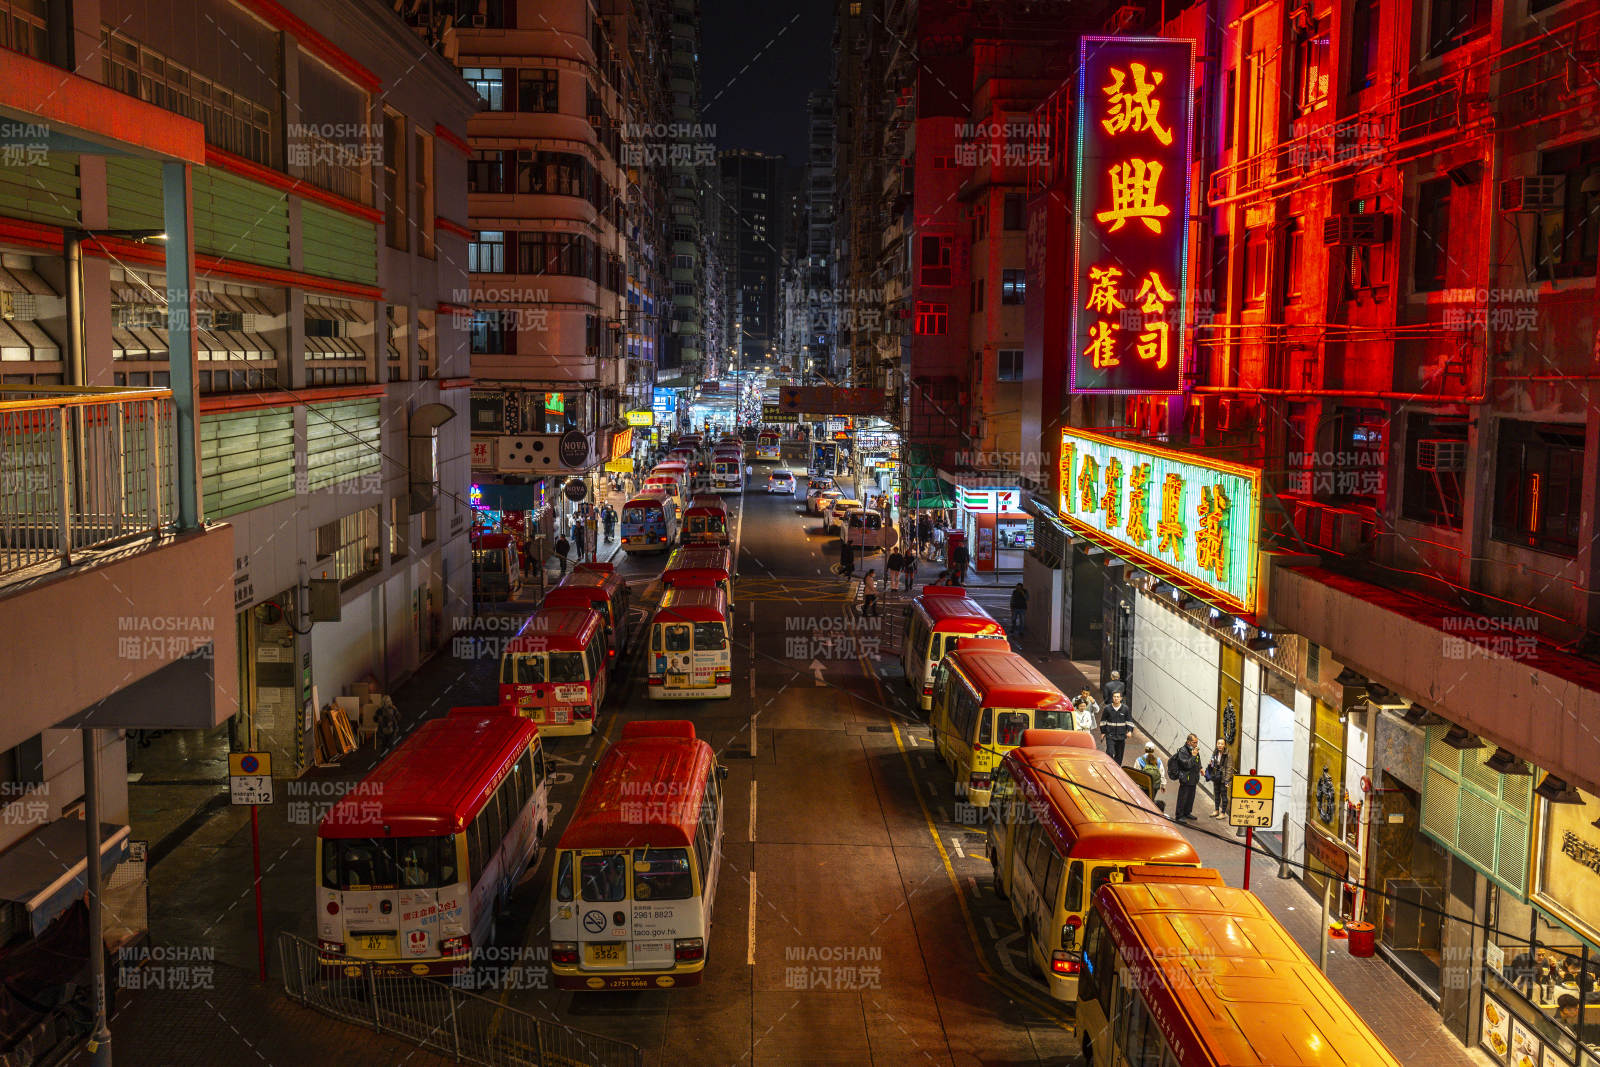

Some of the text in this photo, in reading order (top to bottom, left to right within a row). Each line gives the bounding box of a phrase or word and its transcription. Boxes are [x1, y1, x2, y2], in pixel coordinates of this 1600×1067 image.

[1097, 62, 1173, 234] 誠興
[1135, 271, 1174, 369] 公司
[564, 441, 586, 454] NOVA
[998, 492, 1012, 511] 7
[256, 778, 263, 787] 7
[258, 793, 270, 803] 12
[1257, 801, 1265, 811] 7
[1257, 816, 1270, 826] 12
[633, 910, 673, 919] 2961 8823
[633, 927, 676, 937] taco.gov.hk
